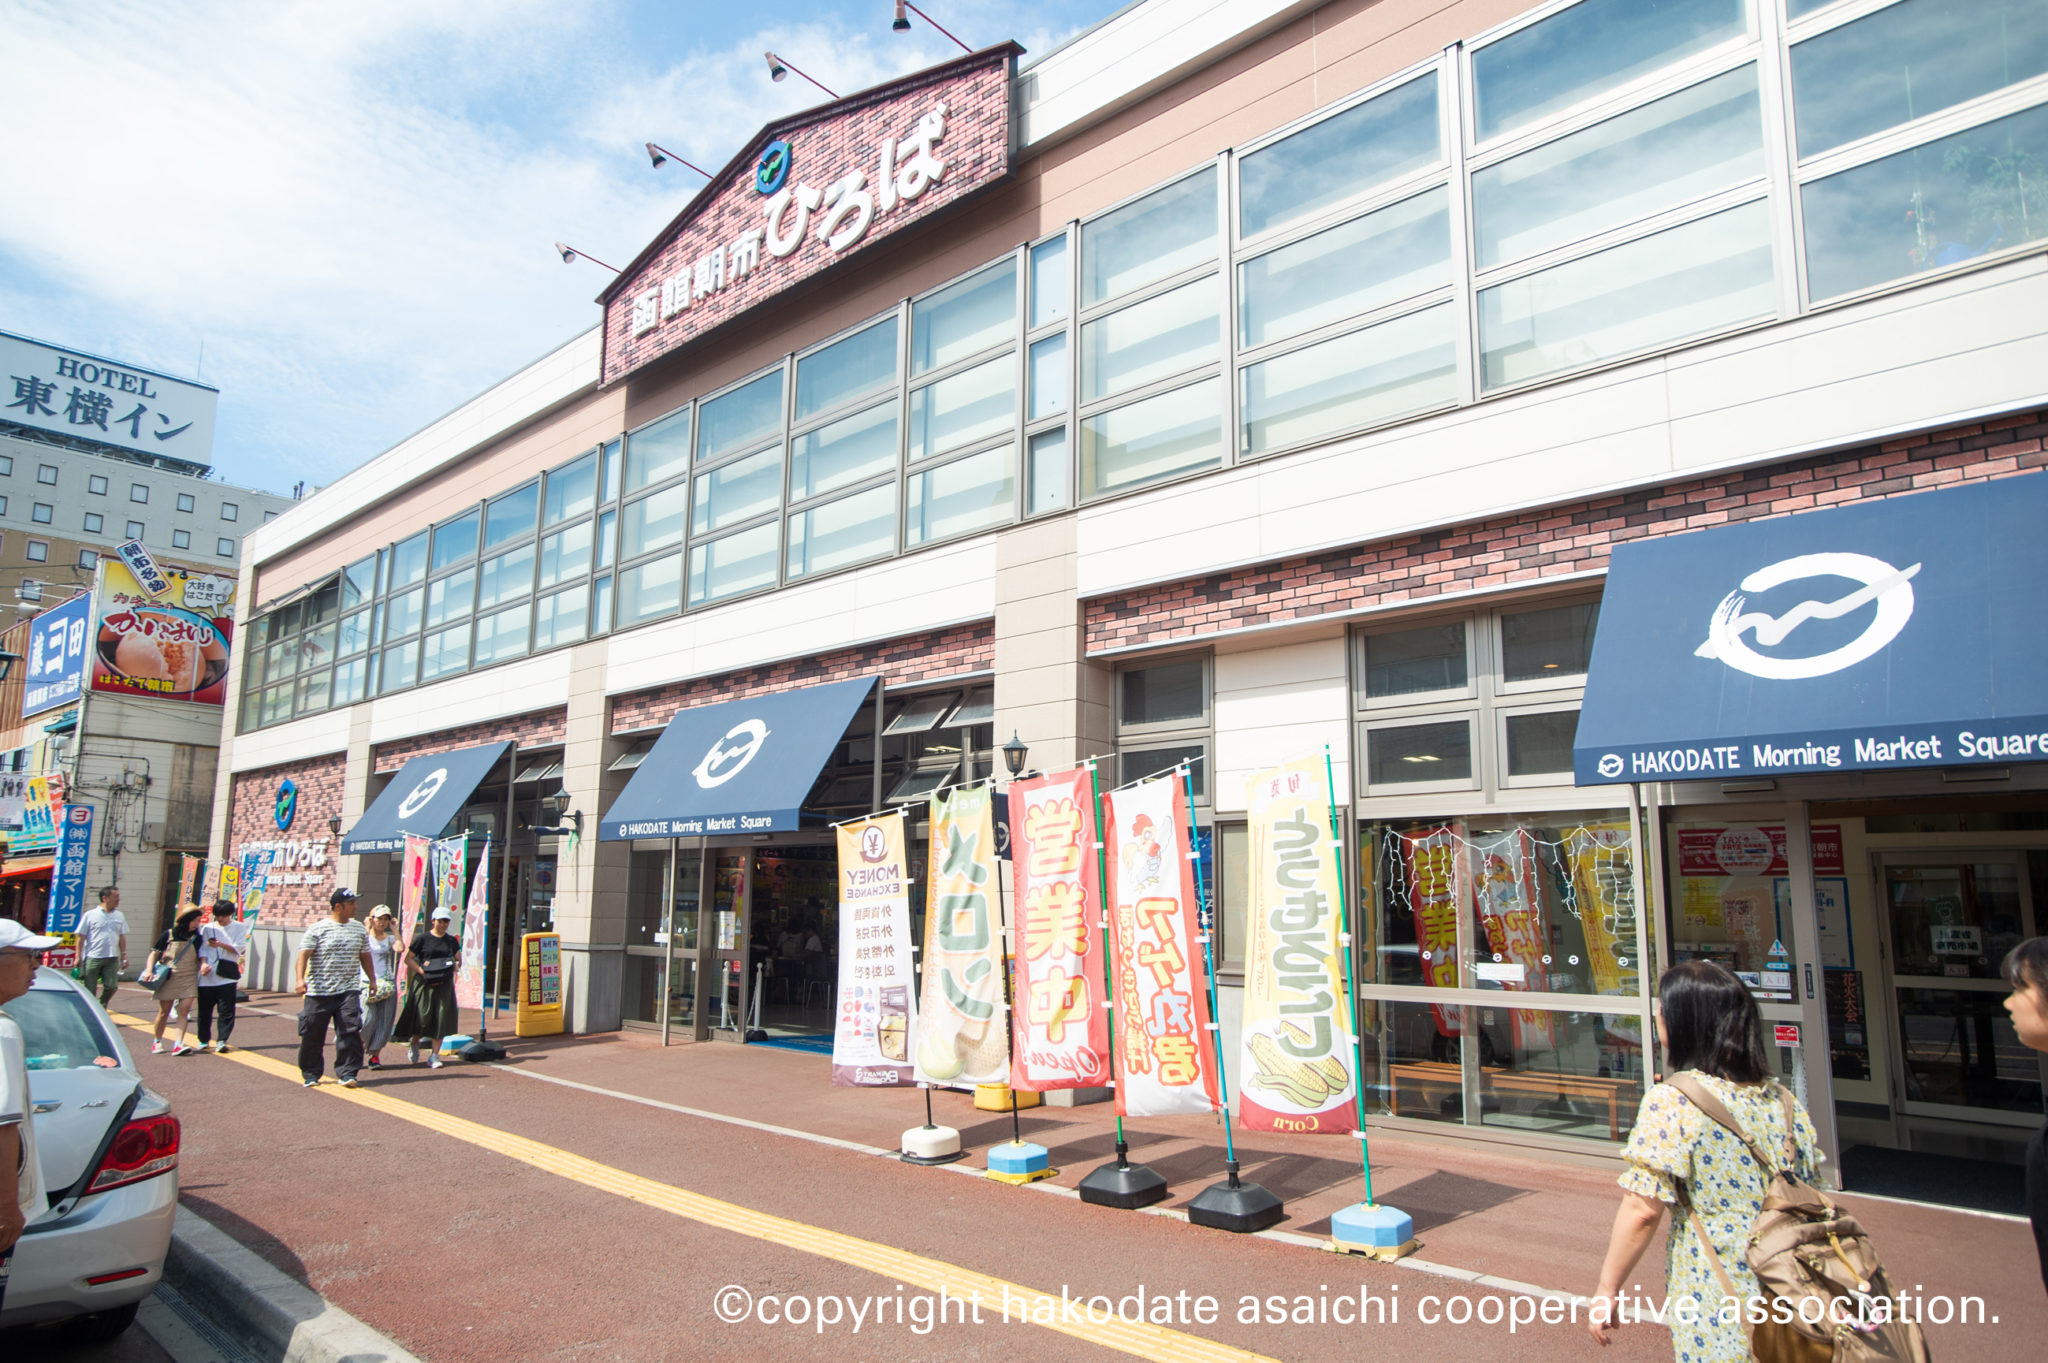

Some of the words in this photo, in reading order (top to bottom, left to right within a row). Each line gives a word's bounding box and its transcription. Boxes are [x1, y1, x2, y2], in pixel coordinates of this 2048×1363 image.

[632, 102, 950, 338] 函館朝市ひろば
[56, 356, 157, 399] HOTEL
[5, 374, 194, 441] 東横イン
[188, 581, 215, 591] 大好き
[1632, 747, 1740, 773] HAKODATE
[1753, 740, 1842, 768] Morning
[1855, 735, 1942, 762] Market
[1958, 729, 2048, 759] Square
[629, 821, 668, 834] HAKODATE
[672, 820, 702, 833] Morning
[706, 818, 736, 830] Market
[740, 816, 772, 828] Square
[1024, 798, 1088, 1045] 営業中
[50, 957, 74, 967] 入口
[1765, 977, 1785, 985] 入口
[1842, 972, 1859, 1023] 花火大会
